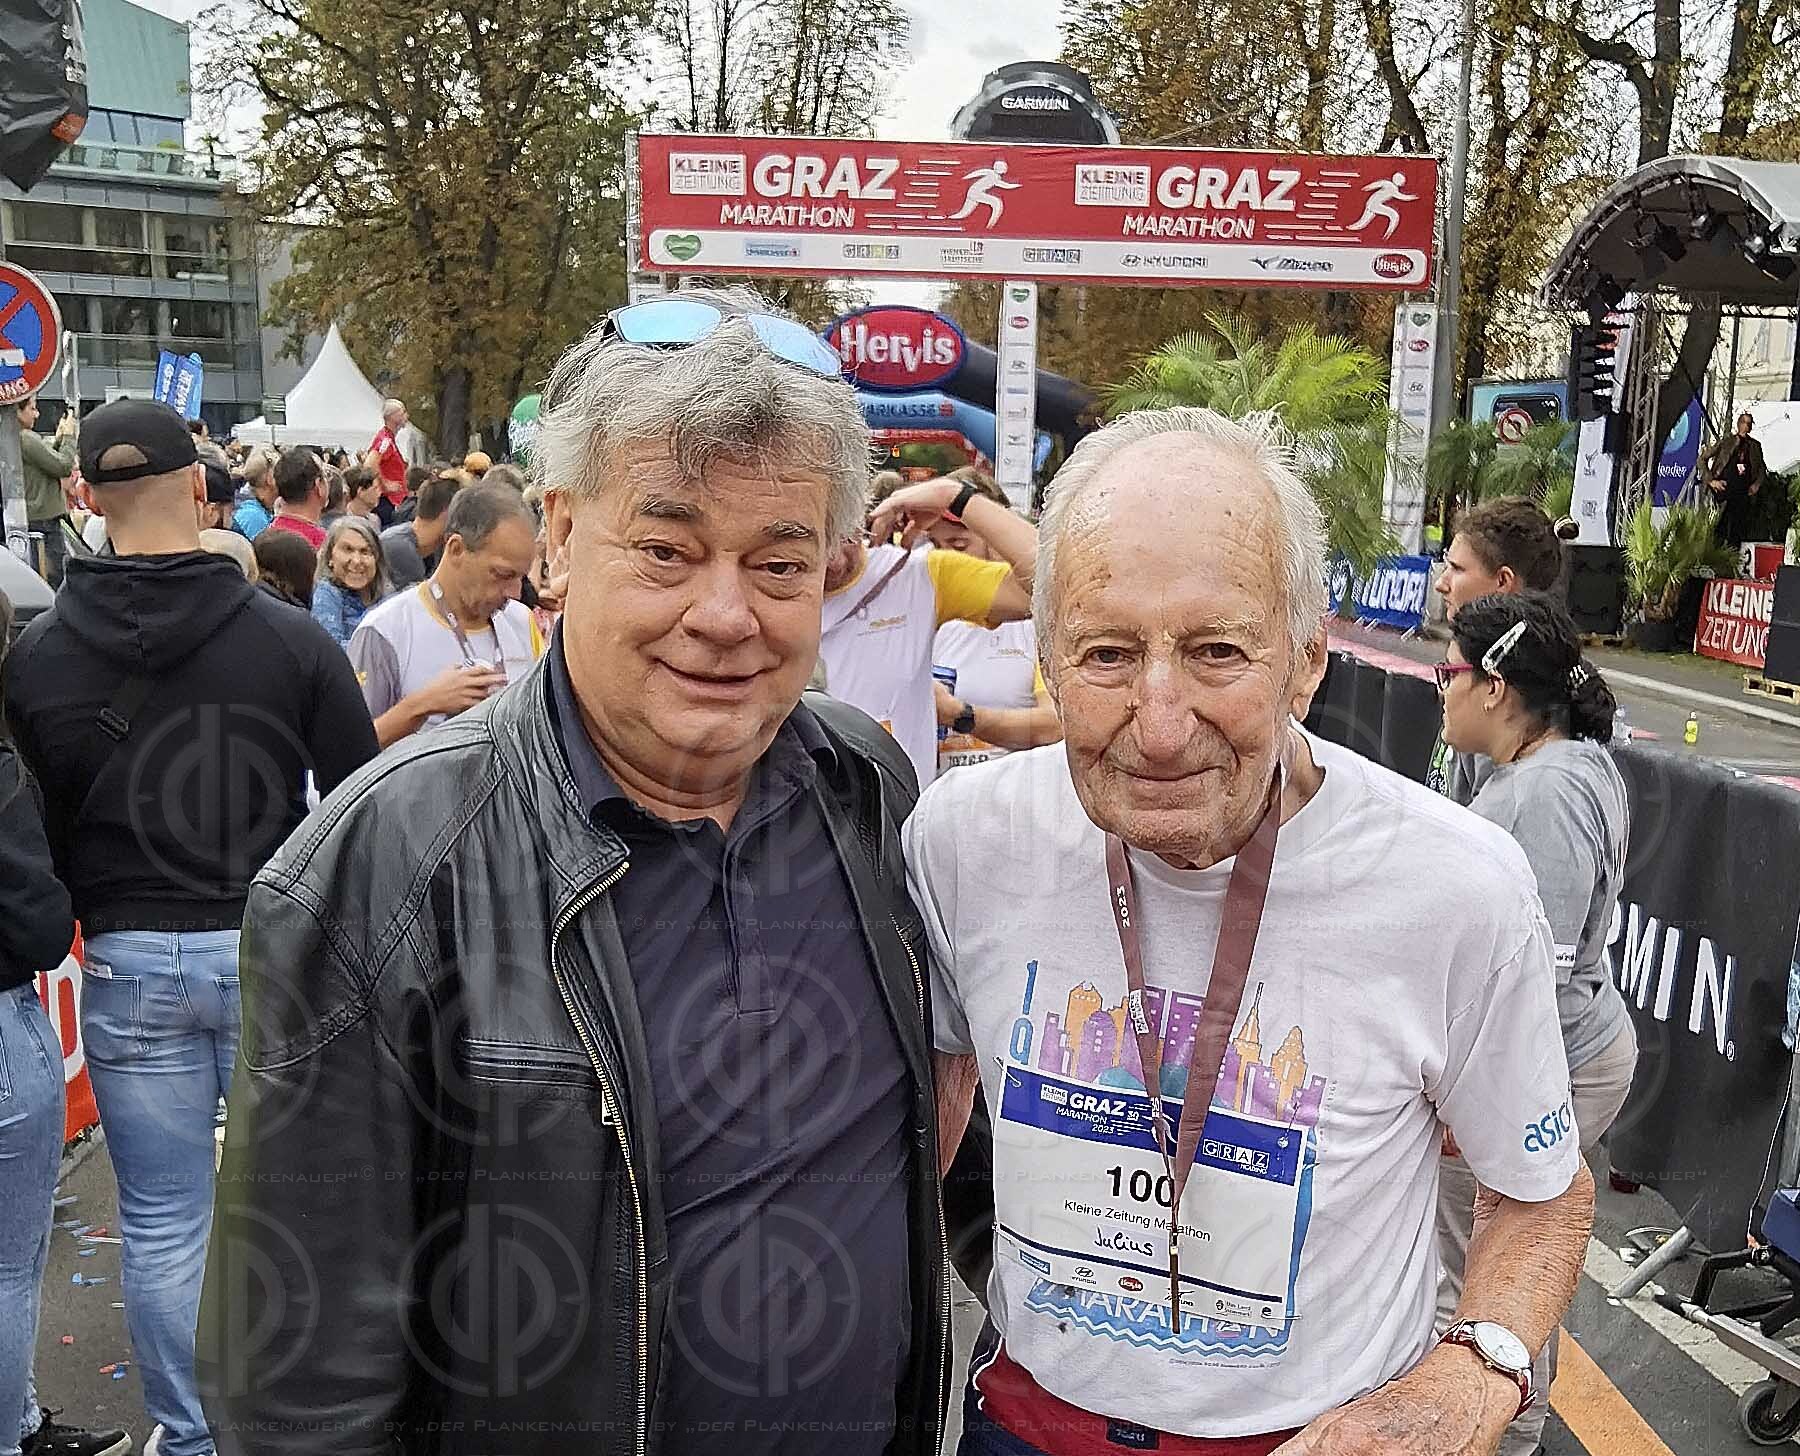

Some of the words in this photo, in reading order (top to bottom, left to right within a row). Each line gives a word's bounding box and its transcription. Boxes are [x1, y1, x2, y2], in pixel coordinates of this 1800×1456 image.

[1001, 97, 1071, 110] GARMIN
[674, 158, 741, 173] KLEINE
[752, 154, 900, 200] GRAZ
[1080, 170, 1145, 185] KLEINE
[674, 175, 741, 190] ZEITUNG
[1079, 186, 1145, 201] ZEITUNG
[1156, 166, 1301, 211] GRAZ
[720, 203, 856, 228] MARATHON
[1122, 214, 1256, 239] MARATHON
[840, 319, 956, 373] Hervis
[1707, 582, 1774, 622] KLEINE
[1056, 1106, 1108, 1125] MARATHON
[1069, 1092, 1127, 1117] GRAZ
[1092, 1123, 1115, 1134] 2023
[1524, 1102, 1571, 1153] asic
[1203, 1140, 1269, 1168] GRAZ
[1106, 1165, 1175, 1208] 100
[1064, 1199, 1102, 1216] Kleine
[1105, 1207, 1151, 1228] Zeitung
[1154, 1217, 1211, 1242] Maathon
[1094, 1226, 1154, 1256] Julius
